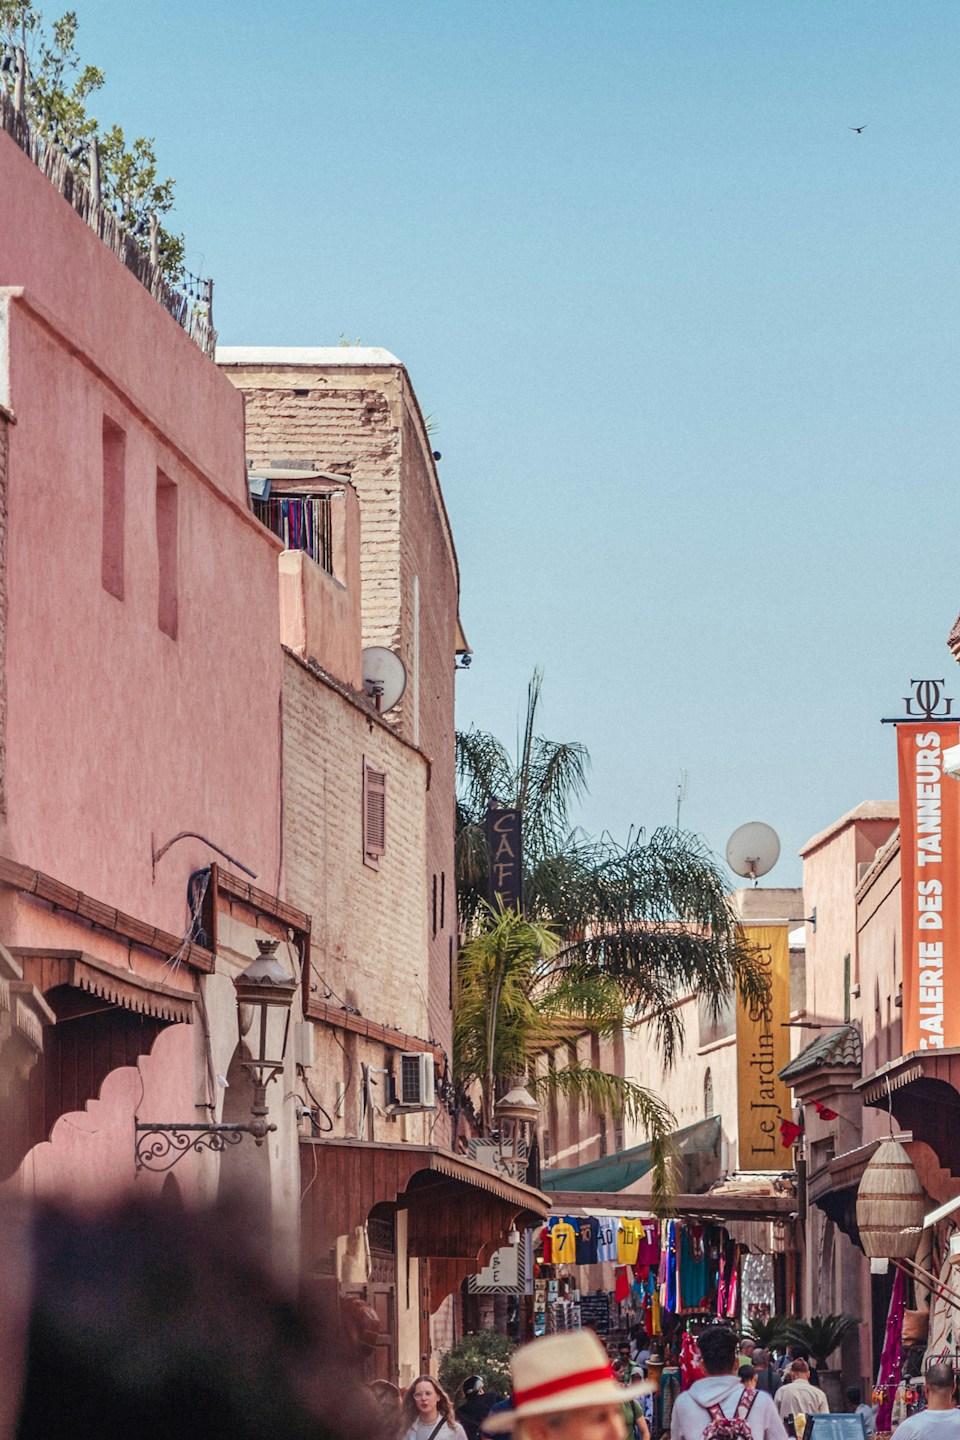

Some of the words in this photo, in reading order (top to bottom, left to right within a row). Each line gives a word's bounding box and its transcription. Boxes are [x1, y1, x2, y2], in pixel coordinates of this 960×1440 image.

[915, 731, 942, 868] TANNEURS
[917, 879, 944, 930] DES
[918, 941, 945, 1050] GALERIE
[750, 1032, 782, 1115] Jardin
[751, 1120, 776, 1156] Le
[556, 1233, 567, 1251] 7
